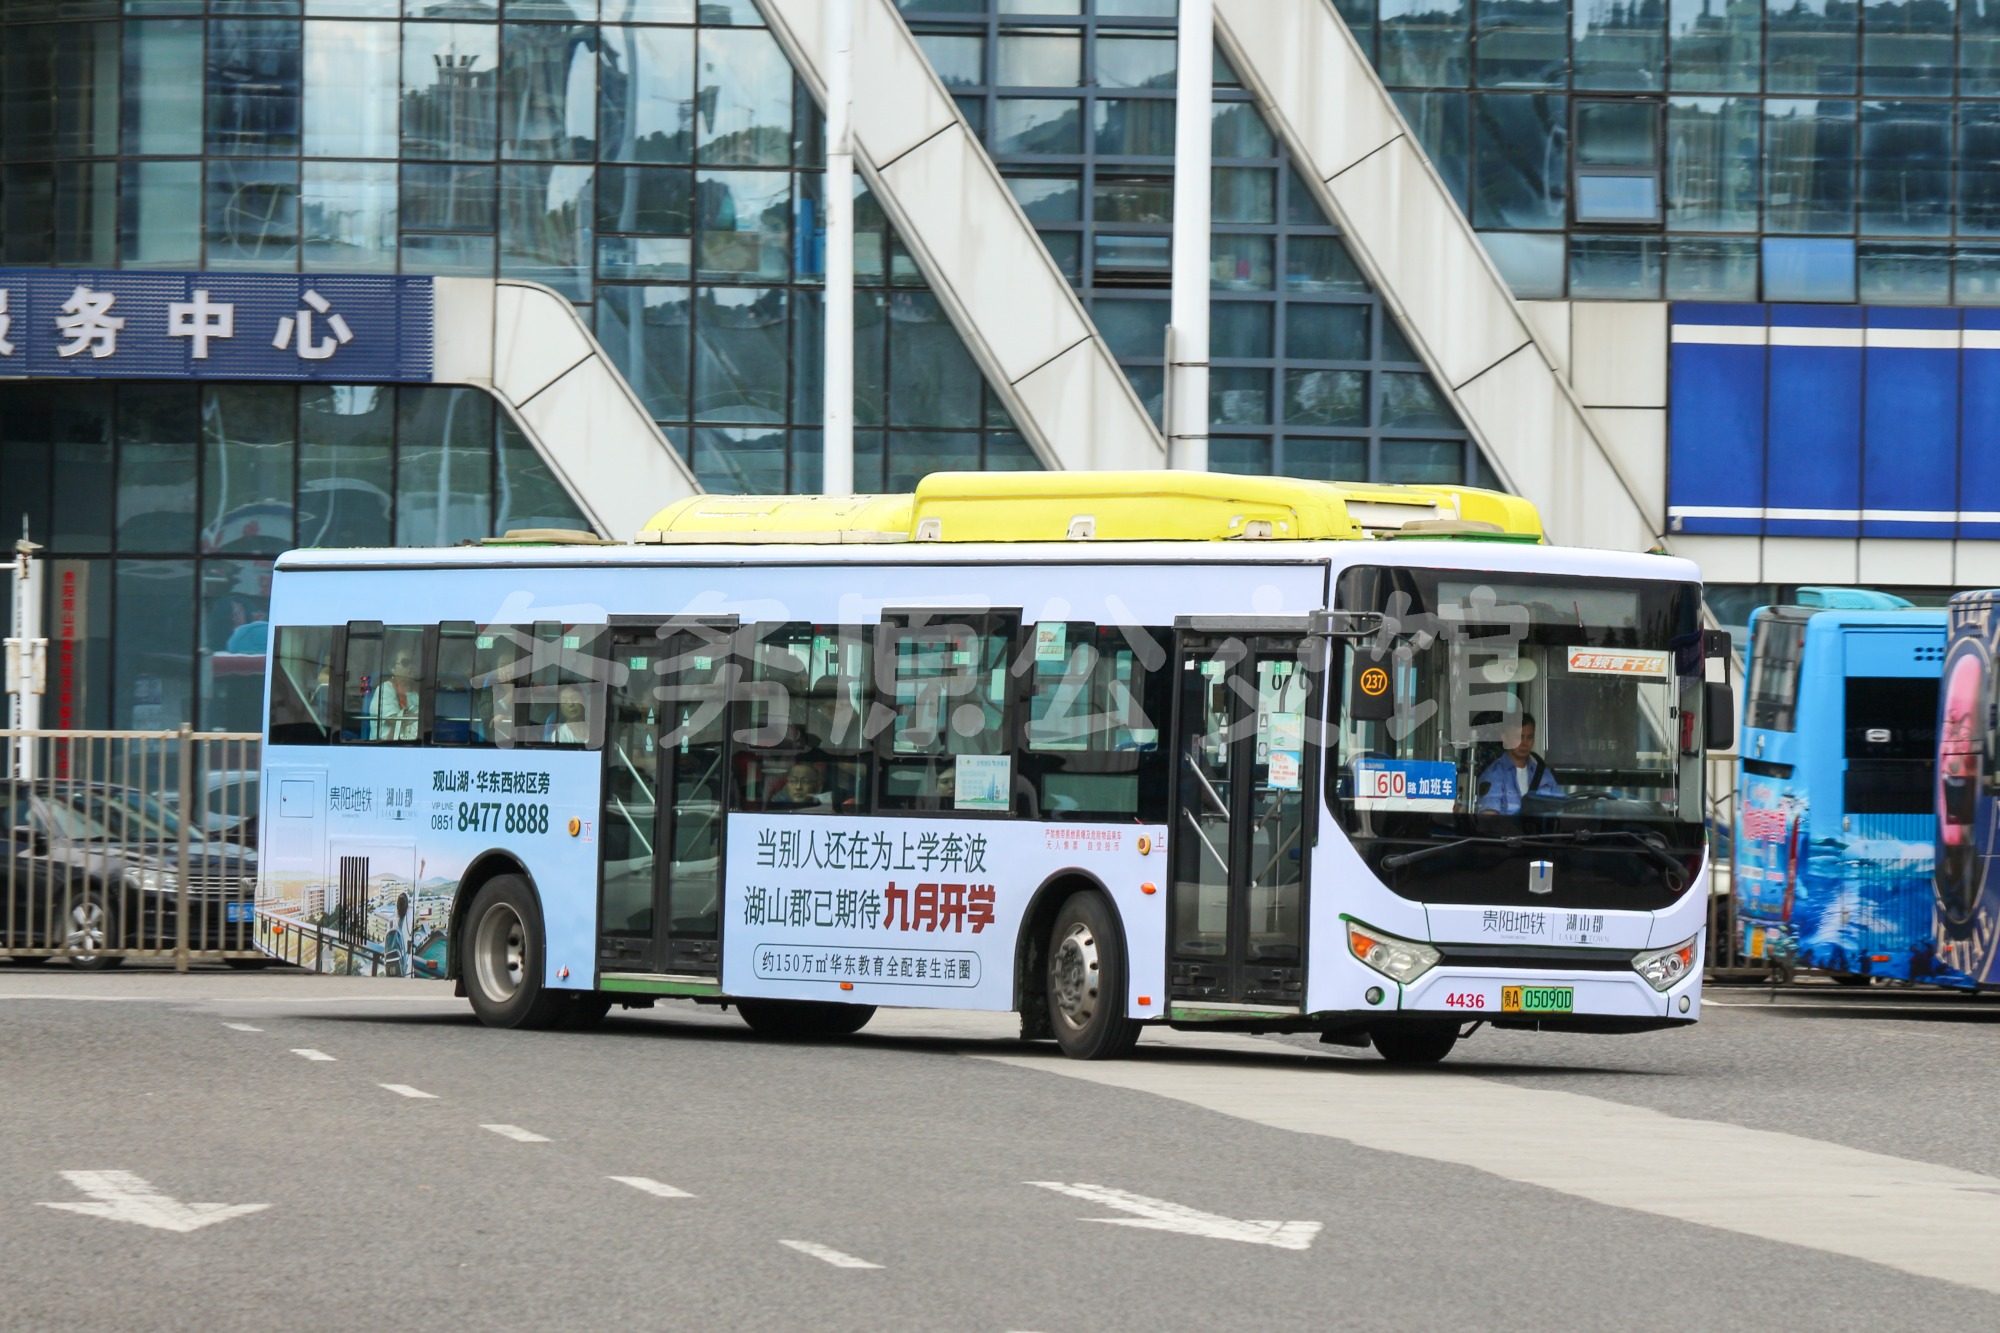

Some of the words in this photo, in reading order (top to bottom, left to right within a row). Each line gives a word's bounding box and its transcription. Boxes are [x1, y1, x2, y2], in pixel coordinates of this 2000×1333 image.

[0, 285, 354, 359] 务中心
[1365, 675, 1384, 690] 237
[432, 770, 550, 795] 观山湖·华东西校区旁
[1377, 773, 1404, 794] 60
[1407, 781, 1417, 795] 路
[1419, 777, 1453, 796] 加班车
[329, 786, 372, 811] 贵阳地铁
[385, 787, 413, 807] 湖山郡
[431, 802, 441, 810] VIP
[442, 802, 454, 811] LINE
[431, 814, 453, 831] 0851
[457, 801, 502, 832] 8477
[505, 803, 549, 834] 8888
[584, 822, 592, 837] 下
[1155, 832, 1164, 848] 上
[757, 827, 987, 874] 当别人还在为上学奔波
[1483, 910, 1546, 934] 贵阳地铁
[1566, 914, 1603, 933] 湖山郡
[1446, 993, 1485, 1009] 4436
[1525, 990, 1572, 1009] 05090D
